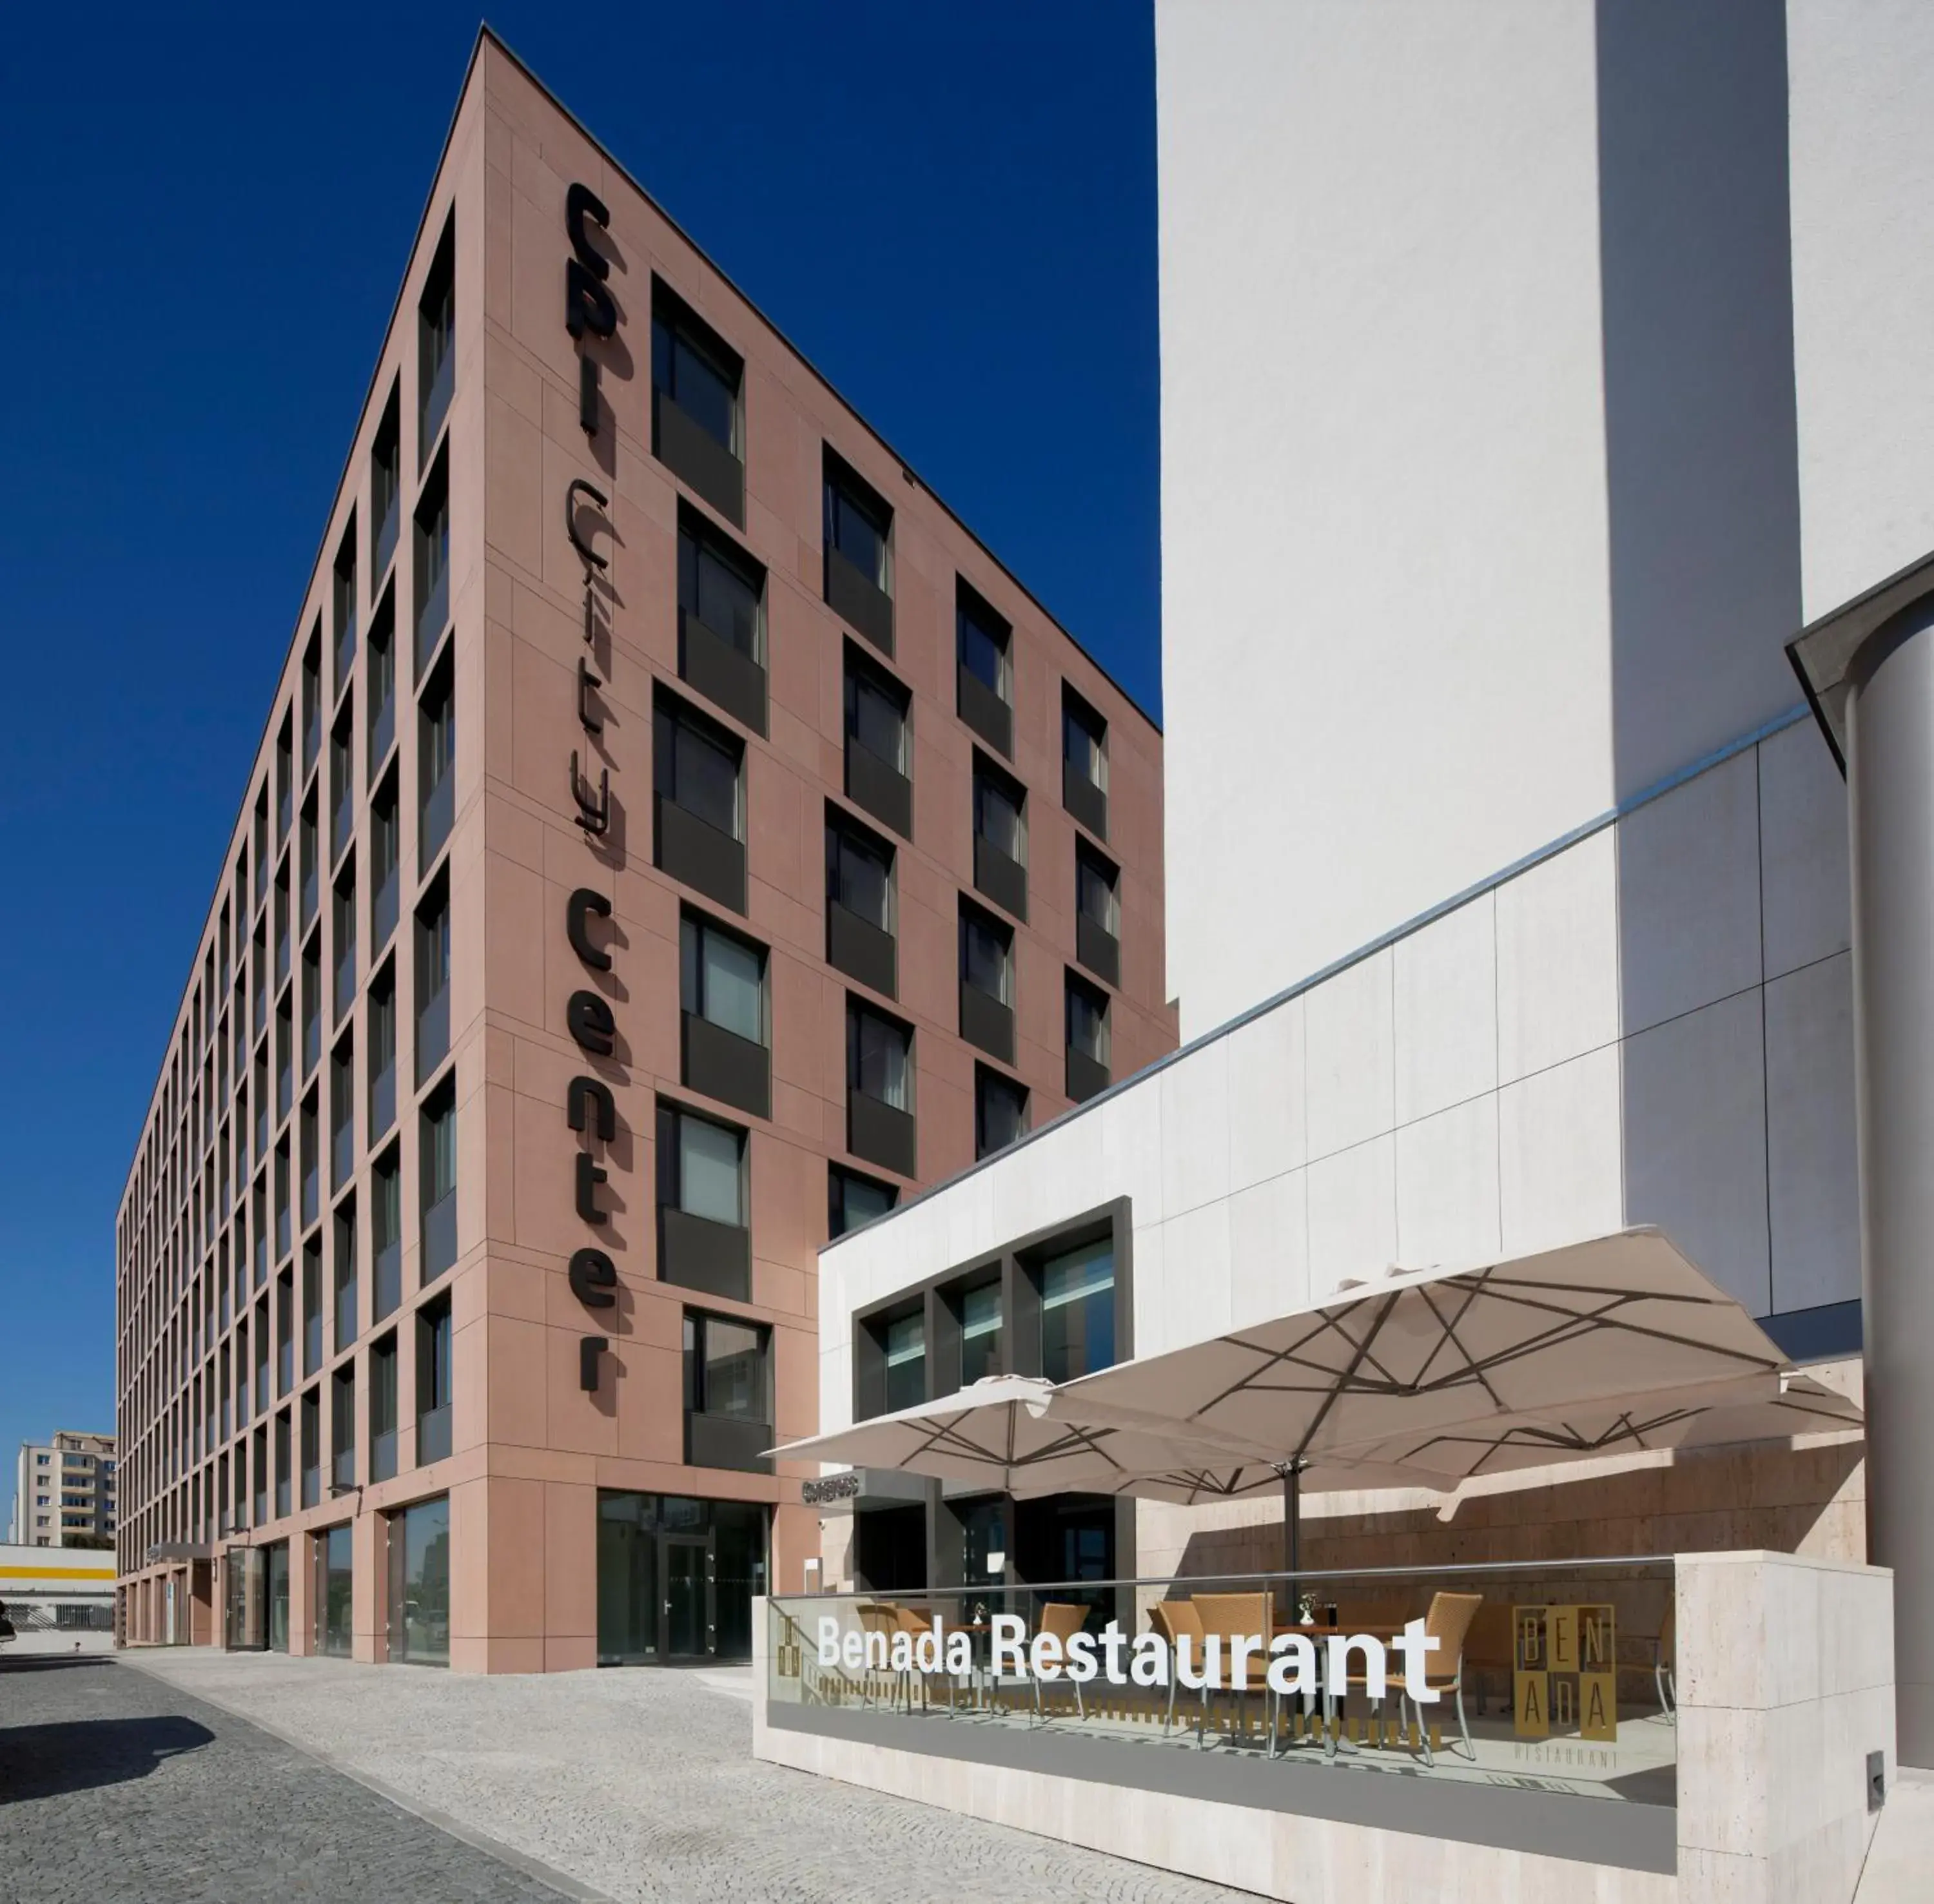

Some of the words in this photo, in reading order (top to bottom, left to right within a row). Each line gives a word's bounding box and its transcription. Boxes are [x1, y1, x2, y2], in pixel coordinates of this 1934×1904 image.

[565, 182, 617, 437] CPI
[566, 478, 609, 836] City
[567, 888, 617, 1392] Center
[817, 1614, 972, 1676] Benada
[991, 1613, 1441, 1704] Restaurant
[1524, 1616, 1604, 1663] BEN
[1525, 1680, 1607, 1728] ADA
